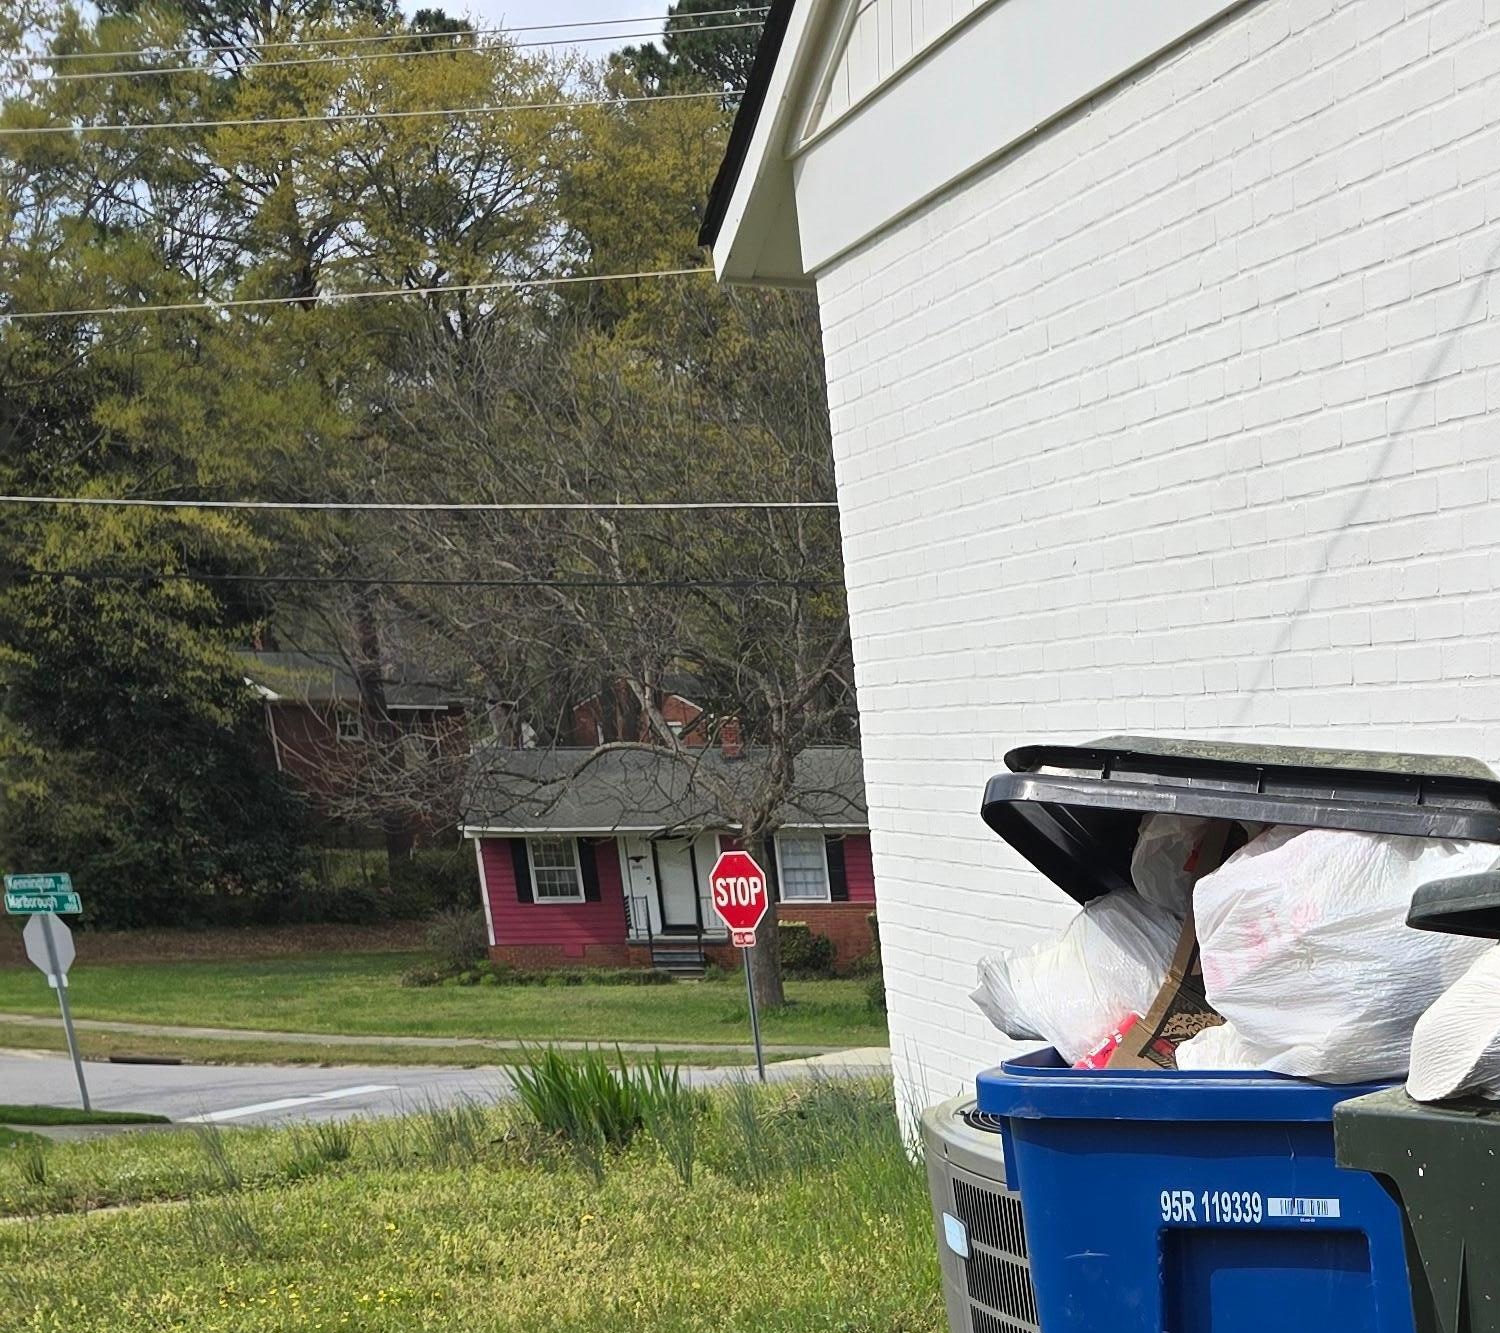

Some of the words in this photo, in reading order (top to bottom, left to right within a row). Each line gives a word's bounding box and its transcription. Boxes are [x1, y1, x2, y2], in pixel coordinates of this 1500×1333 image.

[715, 876, 761, 907] STOP
[1160, 1190, 1197, 1222] 95R
[1201, 1190, 1263, 1223] 119339
